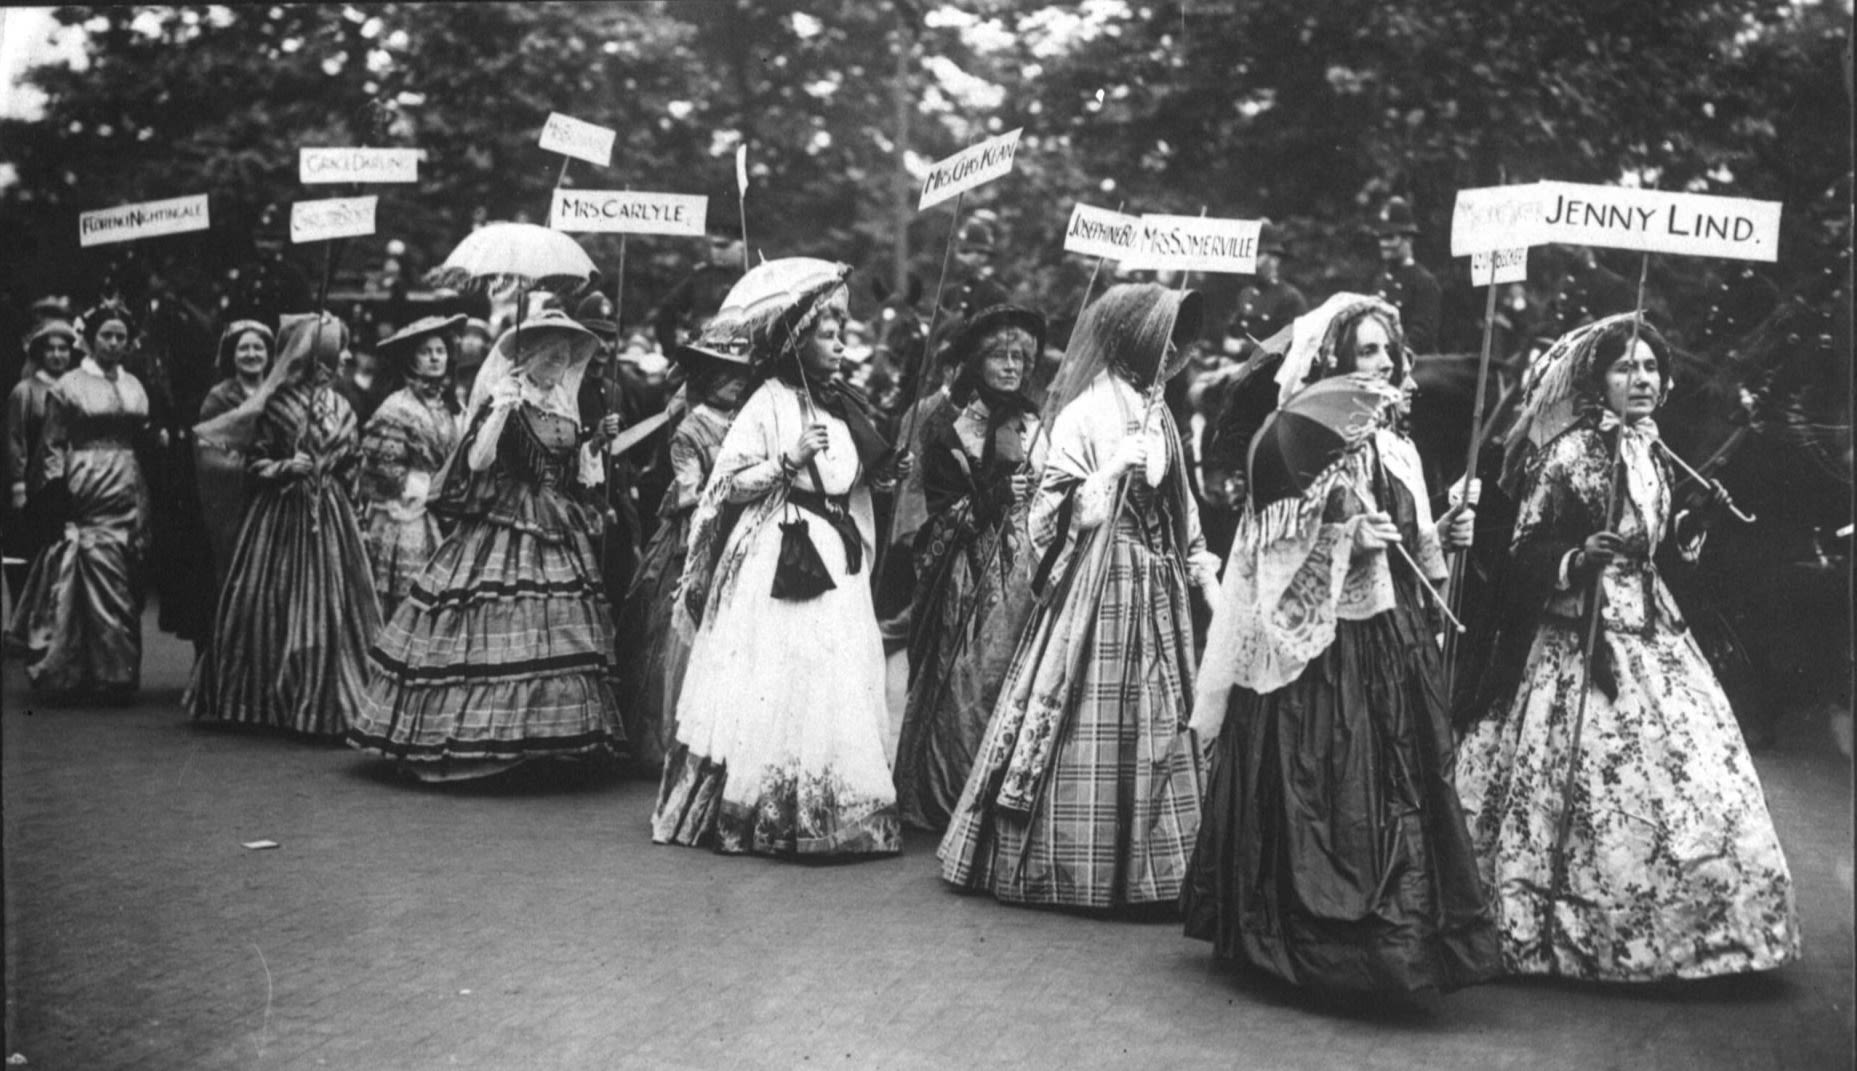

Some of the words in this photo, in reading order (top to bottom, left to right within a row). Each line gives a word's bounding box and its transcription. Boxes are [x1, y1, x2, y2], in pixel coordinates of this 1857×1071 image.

[353, 153, 412, 172] DARLIN
[1545, 194, 1656, 232] JENNY
[1667, 203, 1760, 245] LIND.
[1169, 226, 1256, 259] SOMERVILLE
